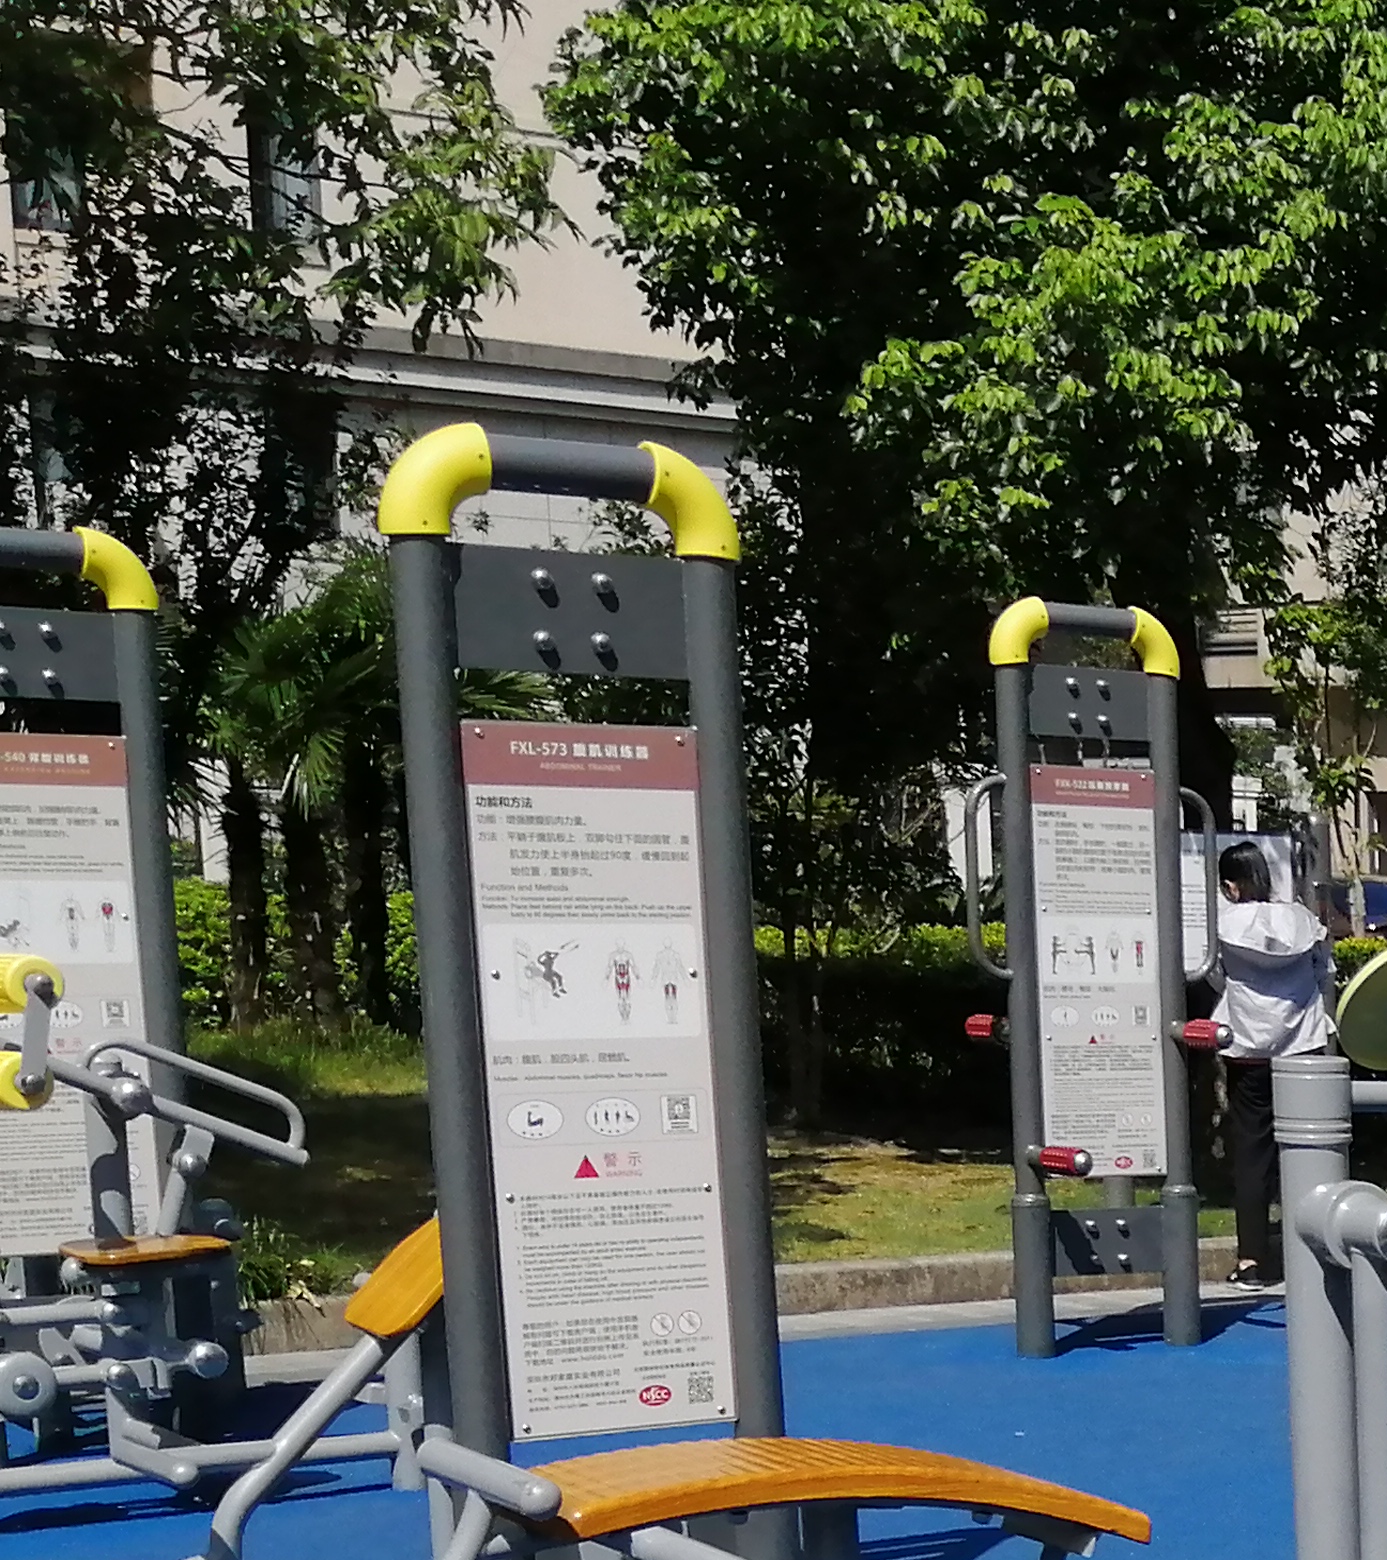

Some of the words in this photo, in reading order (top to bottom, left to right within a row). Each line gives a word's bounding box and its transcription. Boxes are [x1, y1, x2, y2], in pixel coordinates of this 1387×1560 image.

[510, 741, 568, 756] FXL-573
[475, 797, 533, 809] 功能和方法
